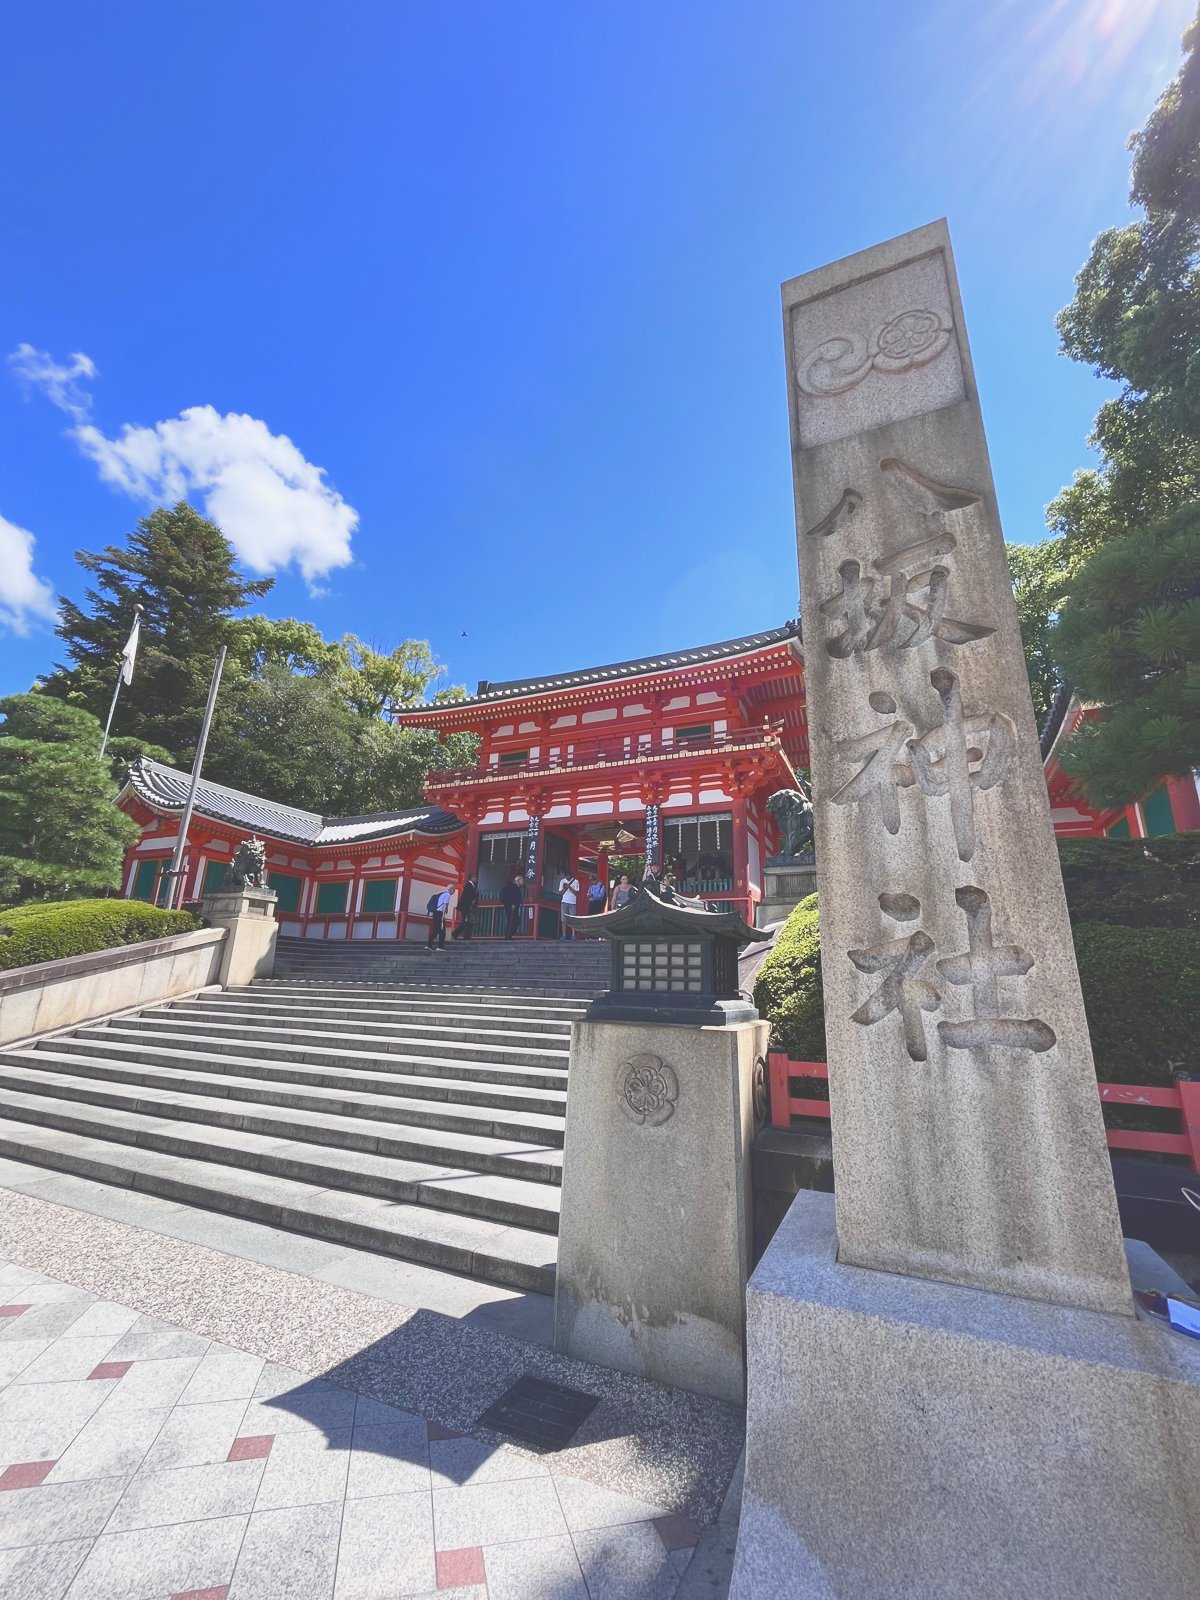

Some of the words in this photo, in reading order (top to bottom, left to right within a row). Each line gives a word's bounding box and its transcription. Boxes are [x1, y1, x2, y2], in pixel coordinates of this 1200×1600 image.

[526, 841, 536, 879] 月次祭
[807, 457, 1057, 1062] 八坂神社
